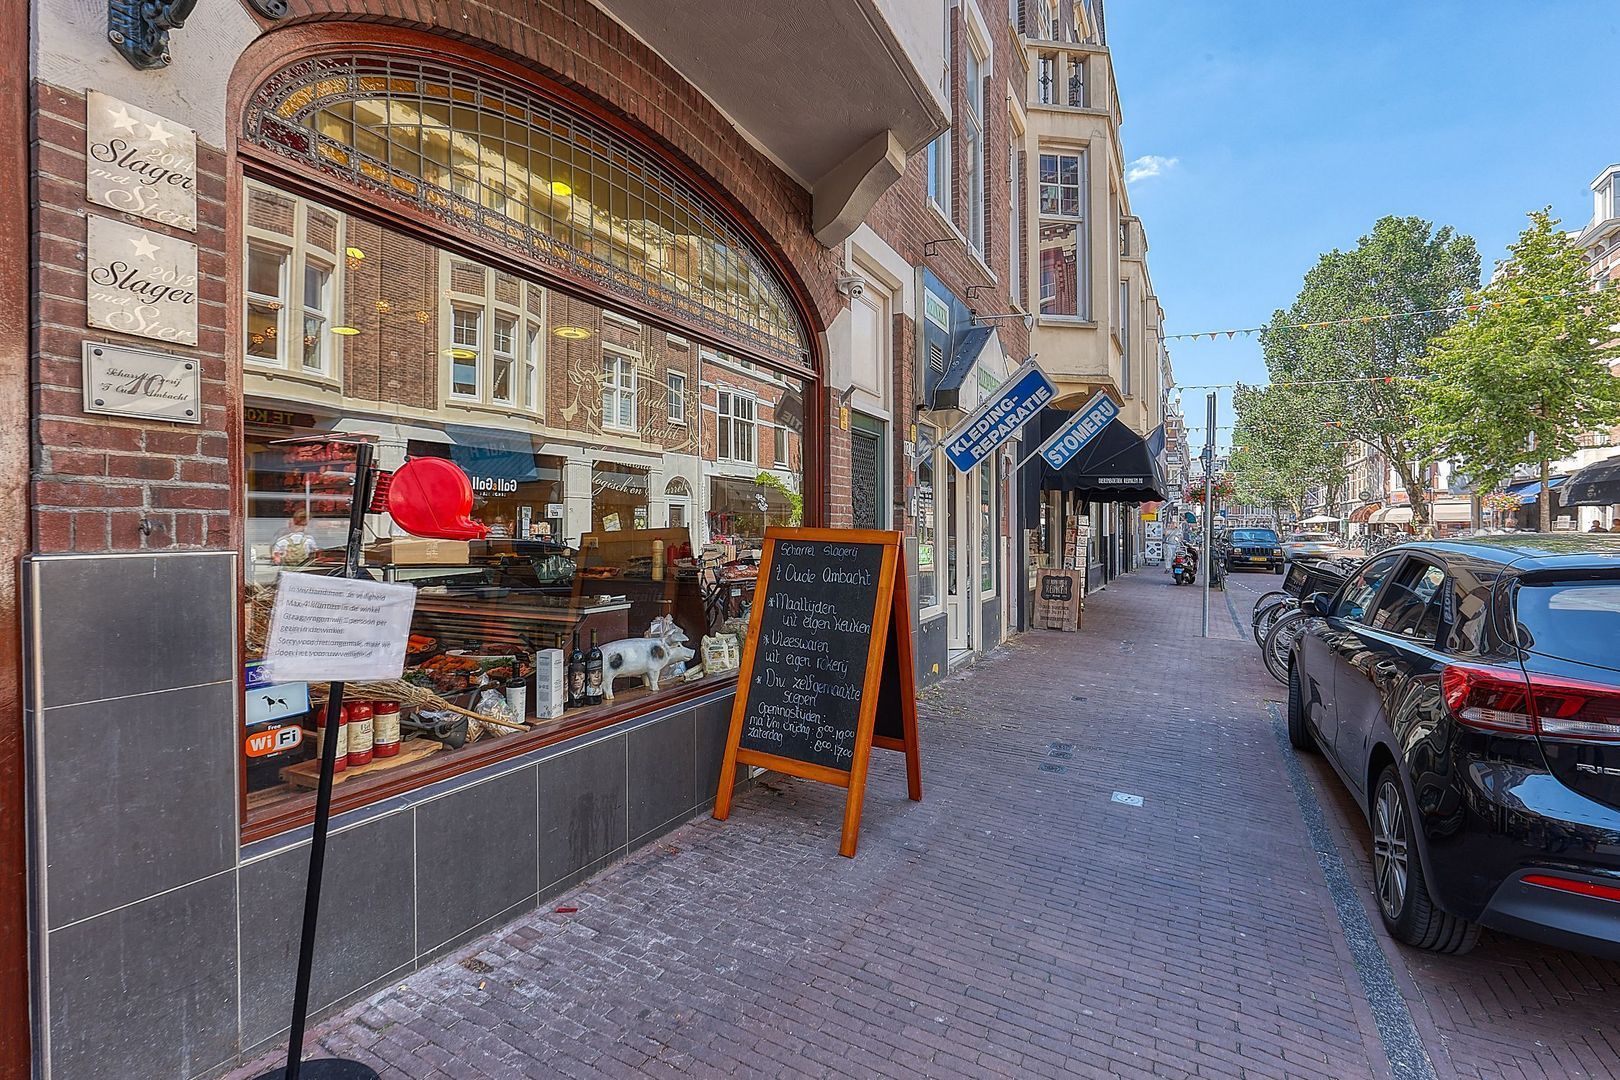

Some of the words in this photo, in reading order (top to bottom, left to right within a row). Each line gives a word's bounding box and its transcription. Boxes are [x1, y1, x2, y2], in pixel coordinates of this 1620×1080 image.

[90, 138, 194, 189] Slager
[90, 168, 130, 185] met
[104, 185, 193, 226] Ster
[90, 261, 194, 305] Slager
[105, 305, 193, 341] Ster
[950, 396, 1018, 457] KLEDING-
[969, 386, 1050, 459] REPARATIE
[1047, 400, 1115, 465] STOMERIJ
[780, 542, 815, 556] Scharrel
[785, 563, 816, 583] Oude
[775, 592, 837, 619] Maaltijden
[782, 612, 798, 627] uit
[803, 616, 831, 635] eigen
[771, 629, 830, 653] Vleeswaren
[765, 649, 781, 663] uit
[785, 652, 811, 672] eigen
[749, 715, 763, 727] ma
